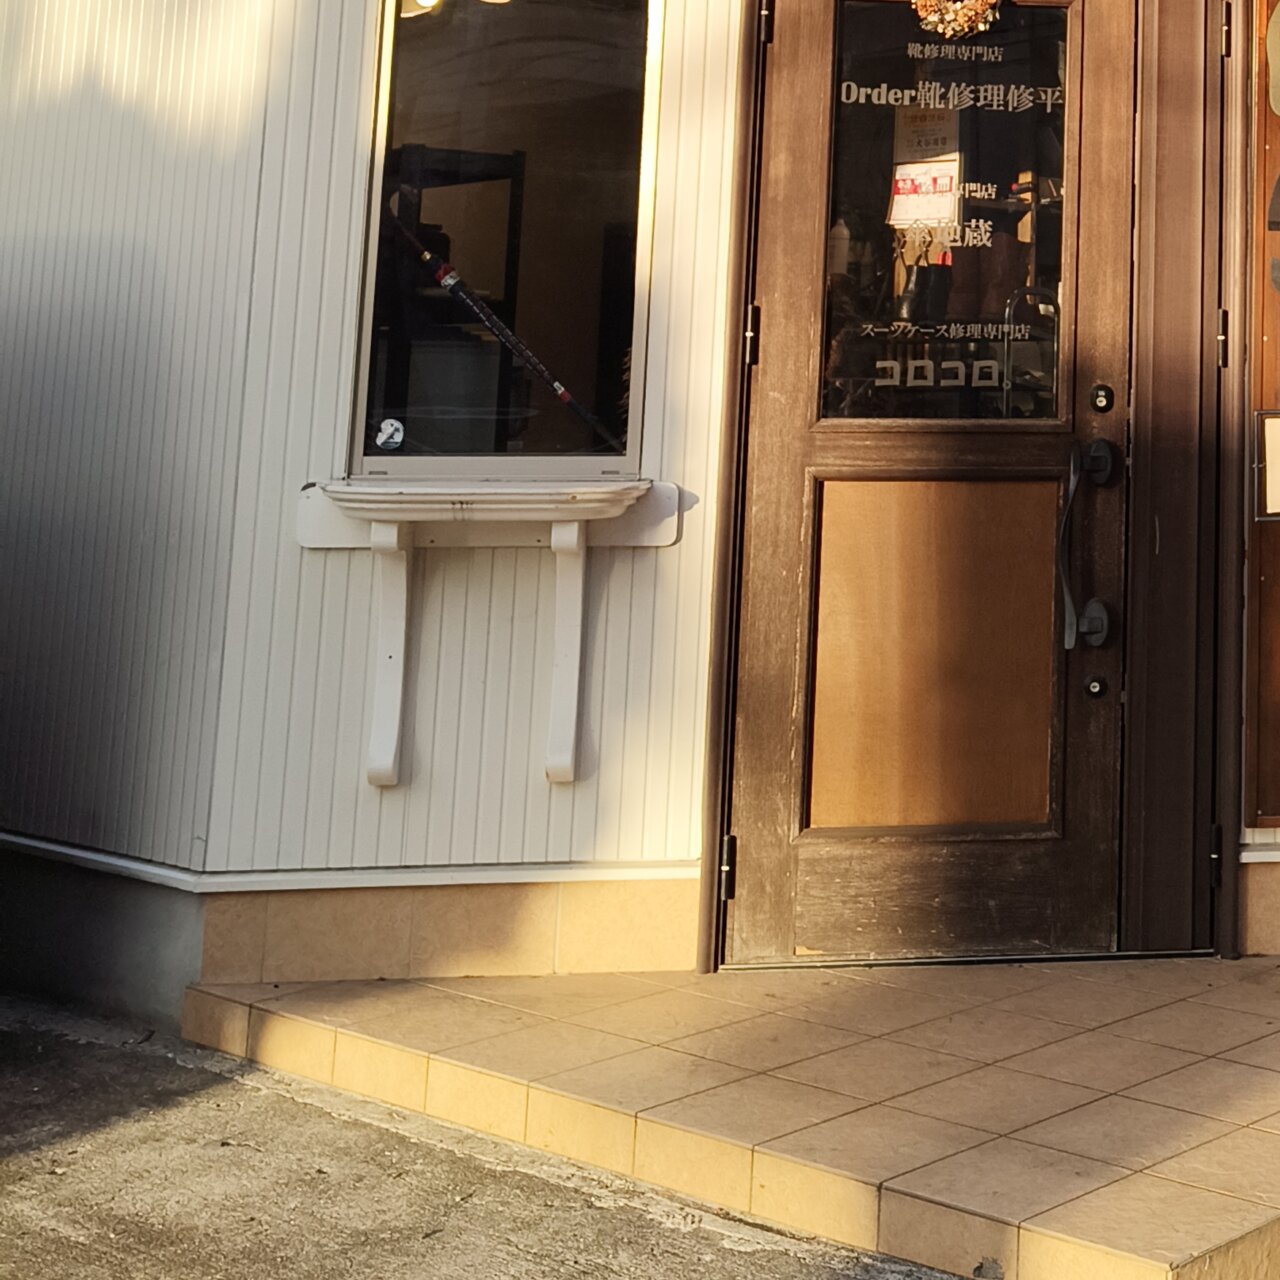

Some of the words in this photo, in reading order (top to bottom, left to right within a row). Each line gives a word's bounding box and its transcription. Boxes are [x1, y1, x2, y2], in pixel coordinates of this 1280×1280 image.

[907, 42, 1004, 62] 靴修理専門店
[841, 81, 1063, 114] Order靴修理修平
[860, 321, 1031, 340] スーツケース修理専門店
[875, 359, 999, 388] コロコロ
